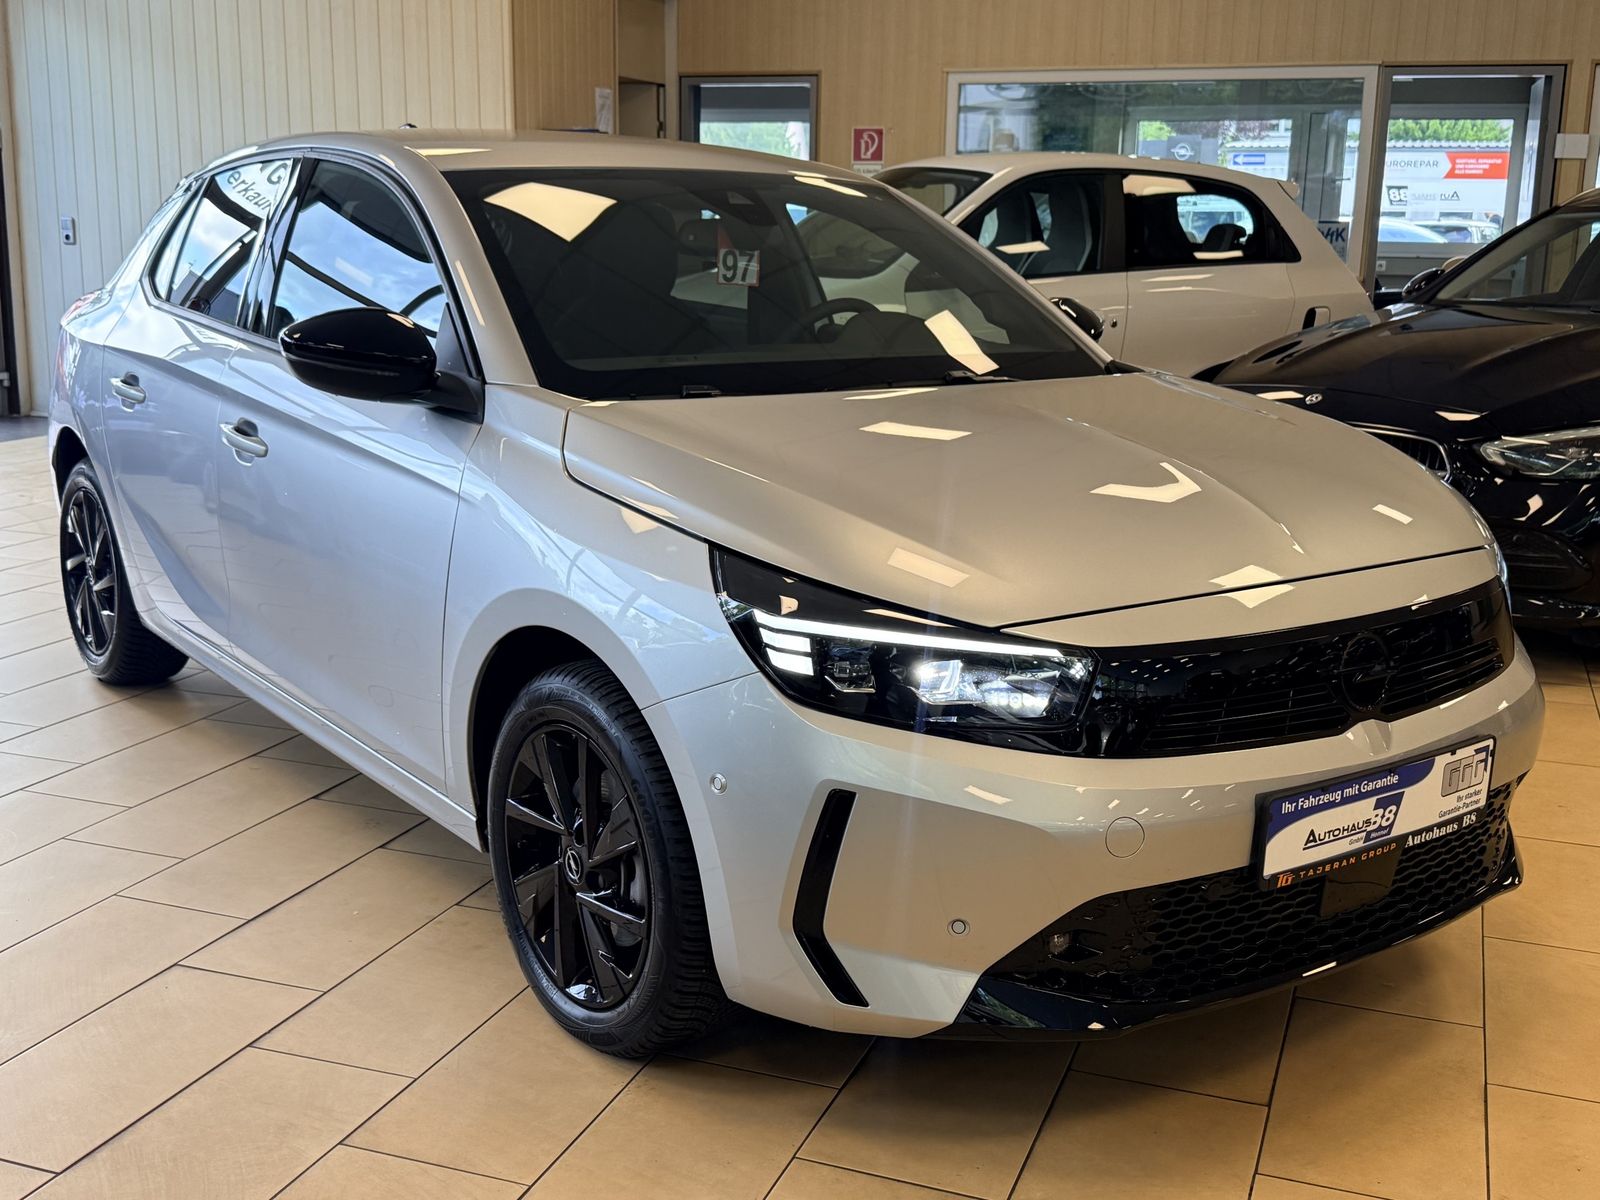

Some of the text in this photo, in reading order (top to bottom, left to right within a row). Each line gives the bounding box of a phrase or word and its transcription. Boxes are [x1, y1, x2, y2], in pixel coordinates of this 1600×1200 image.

[1386, 159, 1439, 169] UROREPAR
[721, 249, 756, 283] 97
[1281, 773, 1399, 814] Ihr Fahrzeug mit Garantie
[1404, 811, 1478, 849] Autohaus B8
[1300, 857, 1356, 879] TAJERAN
[1361, 842, 1397, 861] GROUP
